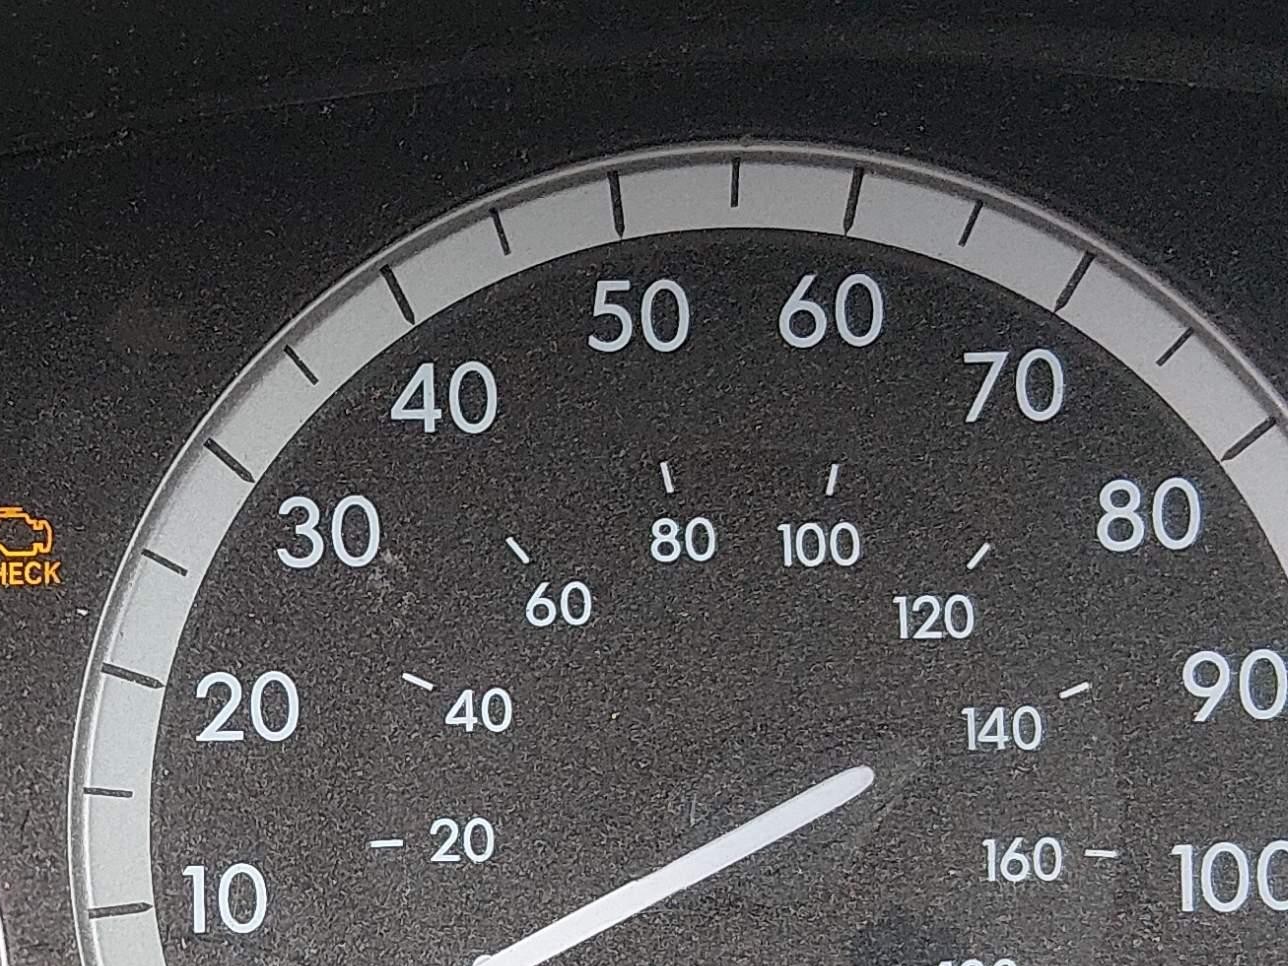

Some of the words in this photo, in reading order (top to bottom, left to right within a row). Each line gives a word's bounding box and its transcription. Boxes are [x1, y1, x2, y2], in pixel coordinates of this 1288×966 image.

[587, 279, 691, 352] 50
[778, 273, 884, 348] 60
[390, 361, 498, 433] 40
[963, 348, 1065, 423] 70
[276, 495, 381, 569] 30
[650, 517, 716, 563] 80
[778, 521, 861, 566] 100
[1096, 477, 1203, 552] 80
[524, 581, 592, 627] 60
[893, 594, 975, 640] 120
[195, 670, 300, 741] 20
[444, 687, 512, 733] 40
[1182, 648, 1288, 722] 90
[961, 705, 1043, 752] 140
[429, 817, 495, 863] 20
[982, 836, 1063, 882] 160
[1171, 839, 1288, 912] 100
[182, 862, 268, 933] 10
